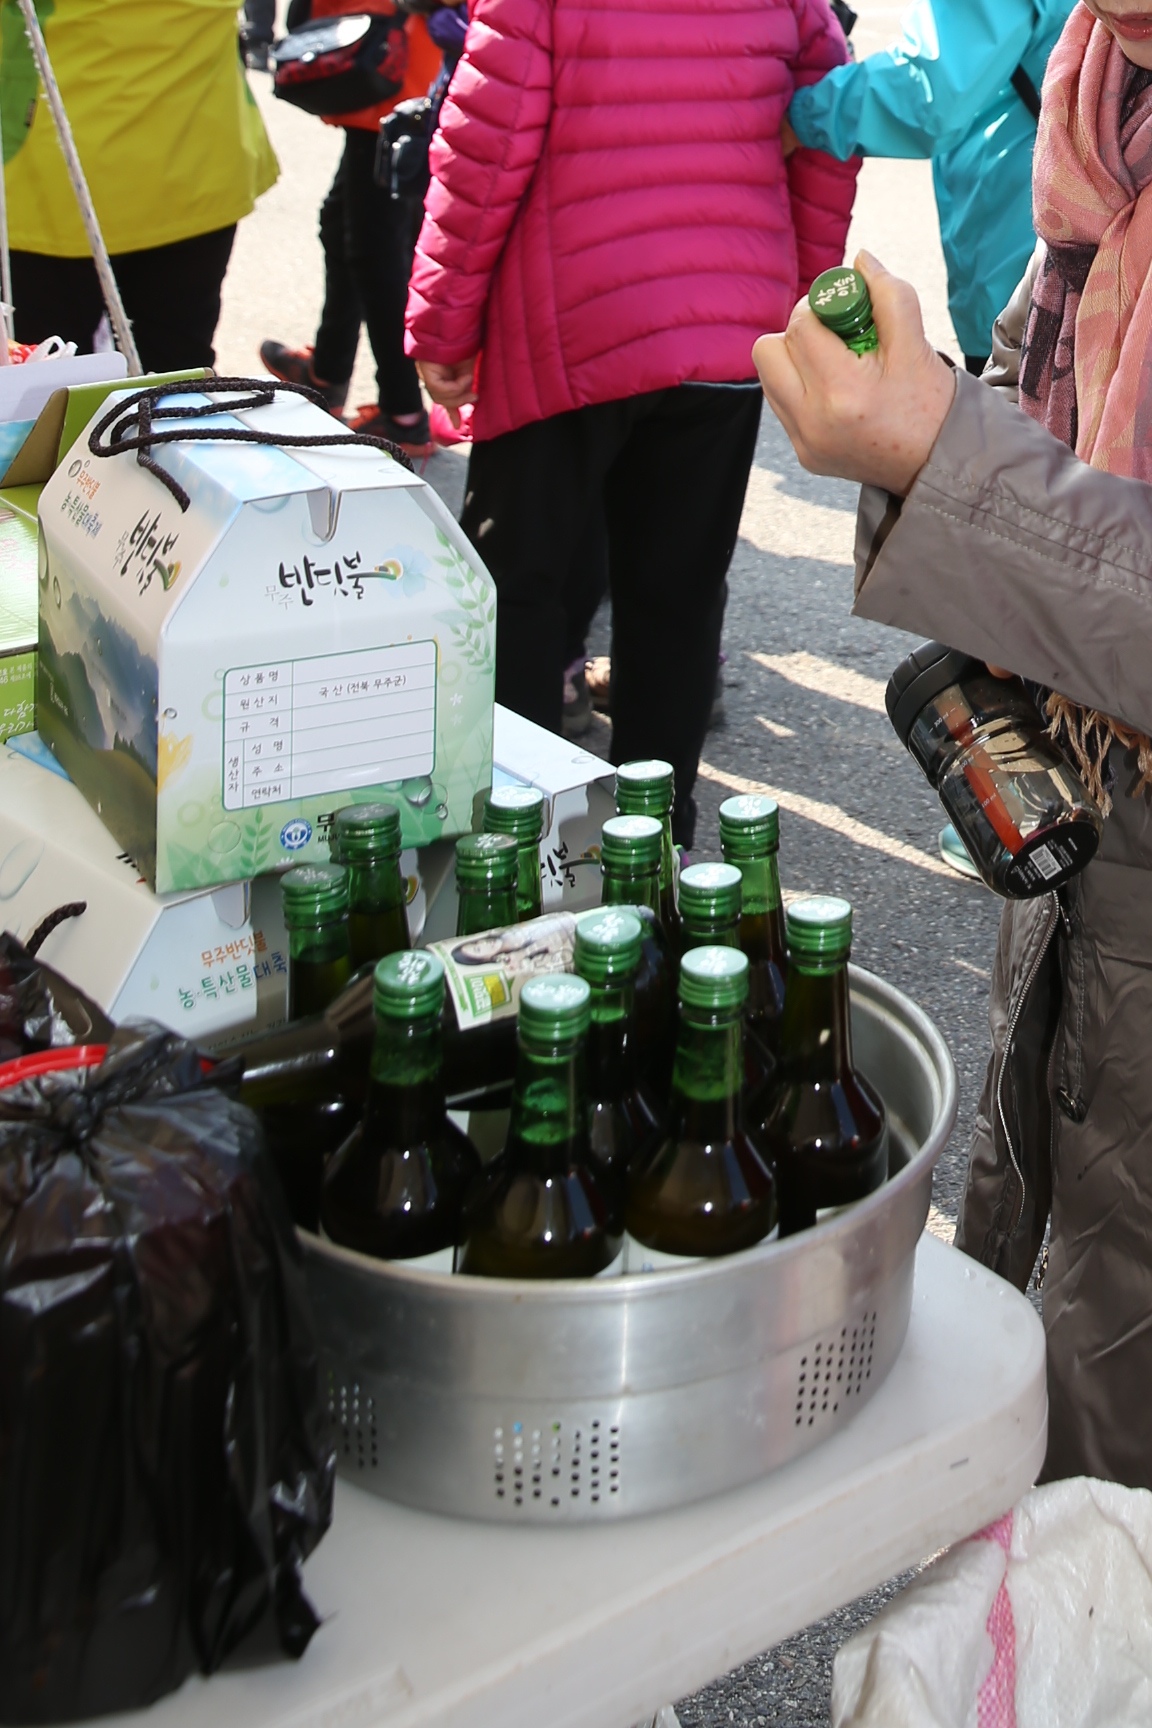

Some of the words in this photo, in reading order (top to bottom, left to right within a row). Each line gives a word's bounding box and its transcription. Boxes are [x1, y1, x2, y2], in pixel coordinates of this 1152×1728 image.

[815, 273, 859, 306] 참이슬
[120, 508, 179, 596] 반딧불
[279, 551, 382, 606] 반딧불
[265, 585, 294, 610] 무주
[373, 675, 407, 690] 무주군)
[251, 784, 282, 799] 연락처
[317, 813, 335, 832] 무
[541, 842, 588, 887] 딧불
[201, 930, 267, 968] 무주반딧불
[178, 951, 287, 1009] 농·특산물대축
